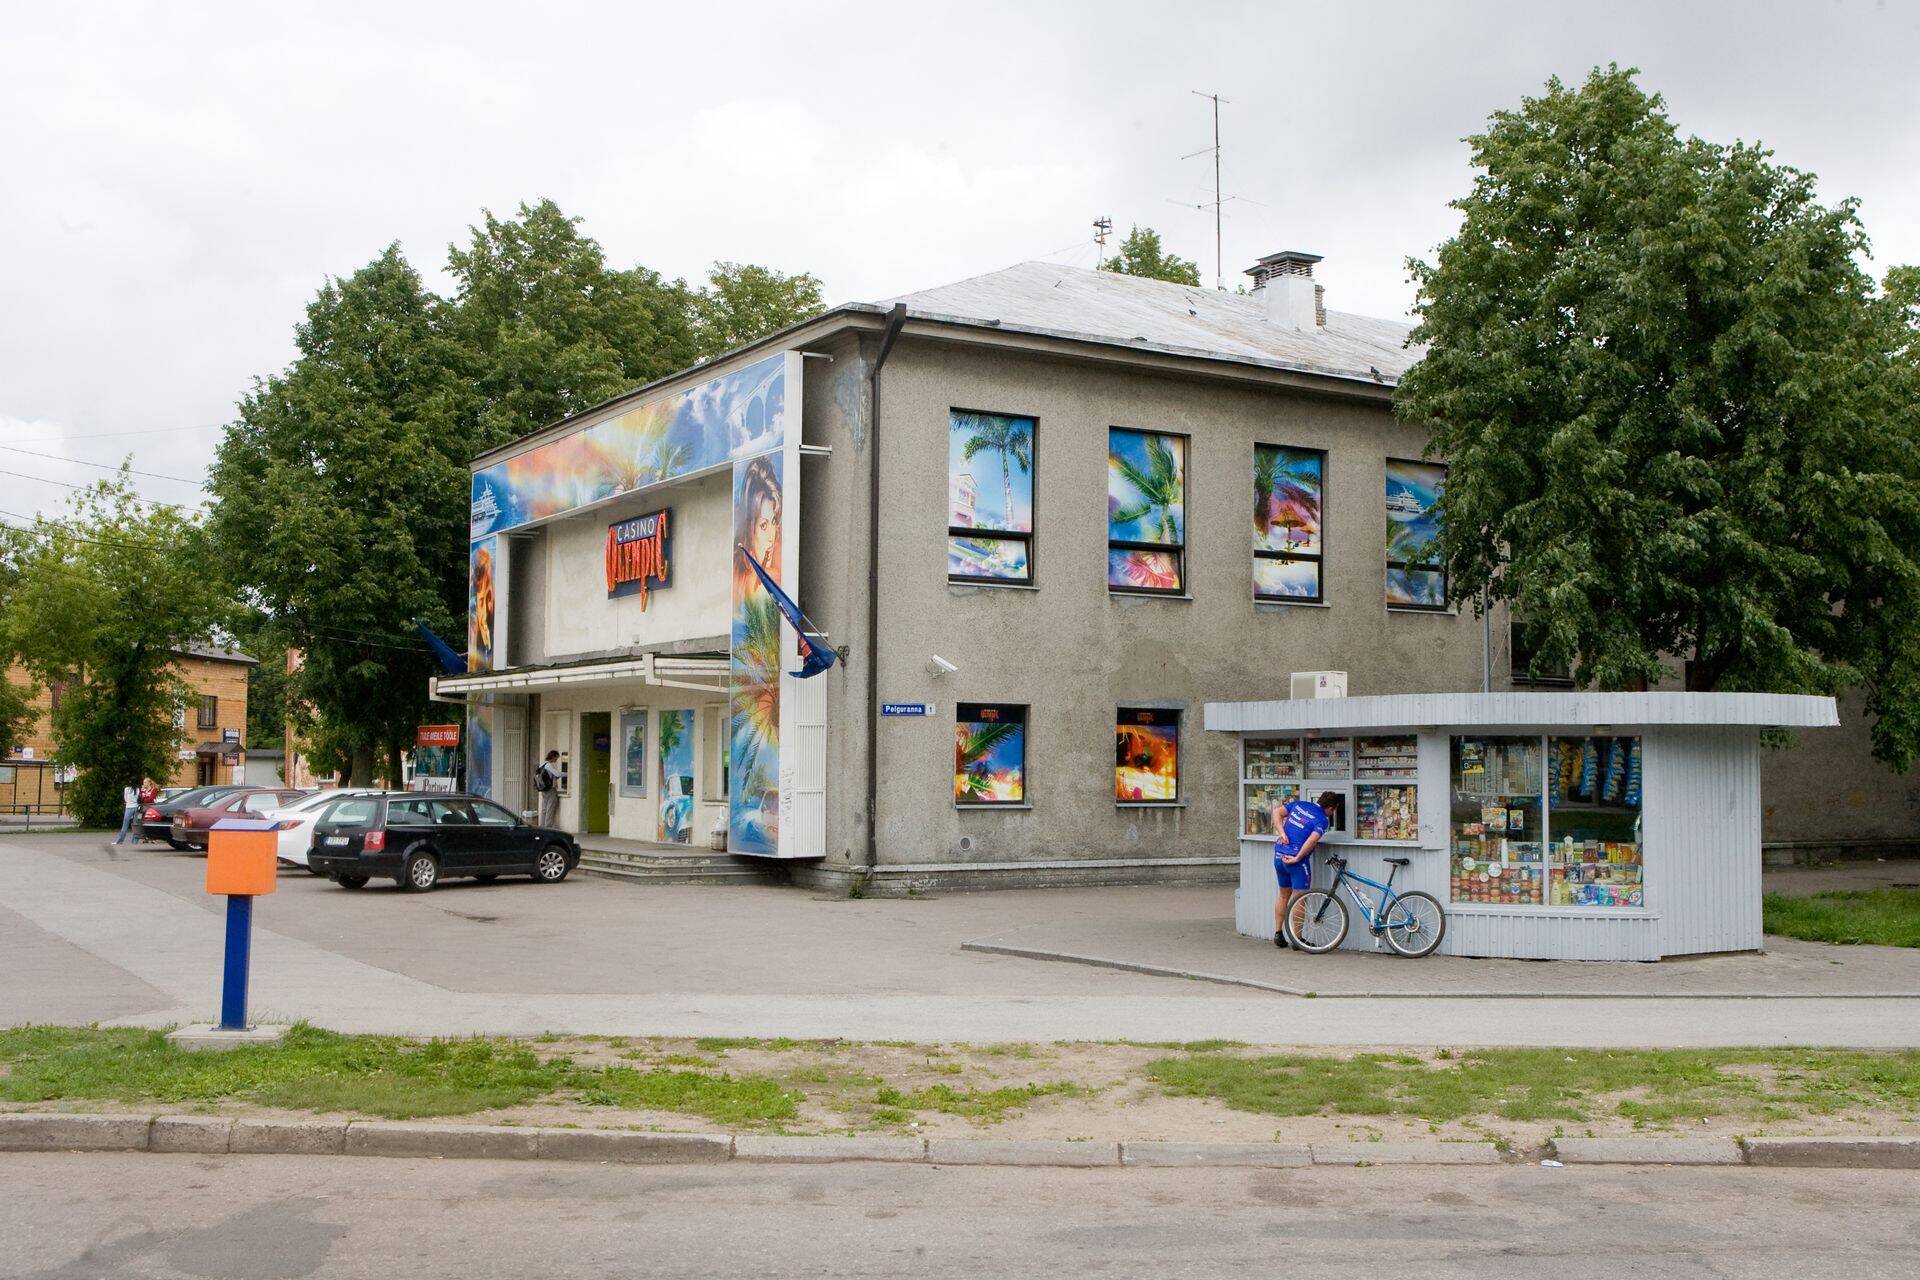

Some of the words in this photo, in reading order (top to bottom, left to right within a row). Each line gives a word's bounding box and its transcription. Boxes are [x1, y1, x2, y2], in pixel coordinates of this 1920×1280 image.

[617, 518, 655, 542] CASINO
[605, 510, 668, 613] OLYMPIC
[885, 705, 922, 714] Pelguranna
